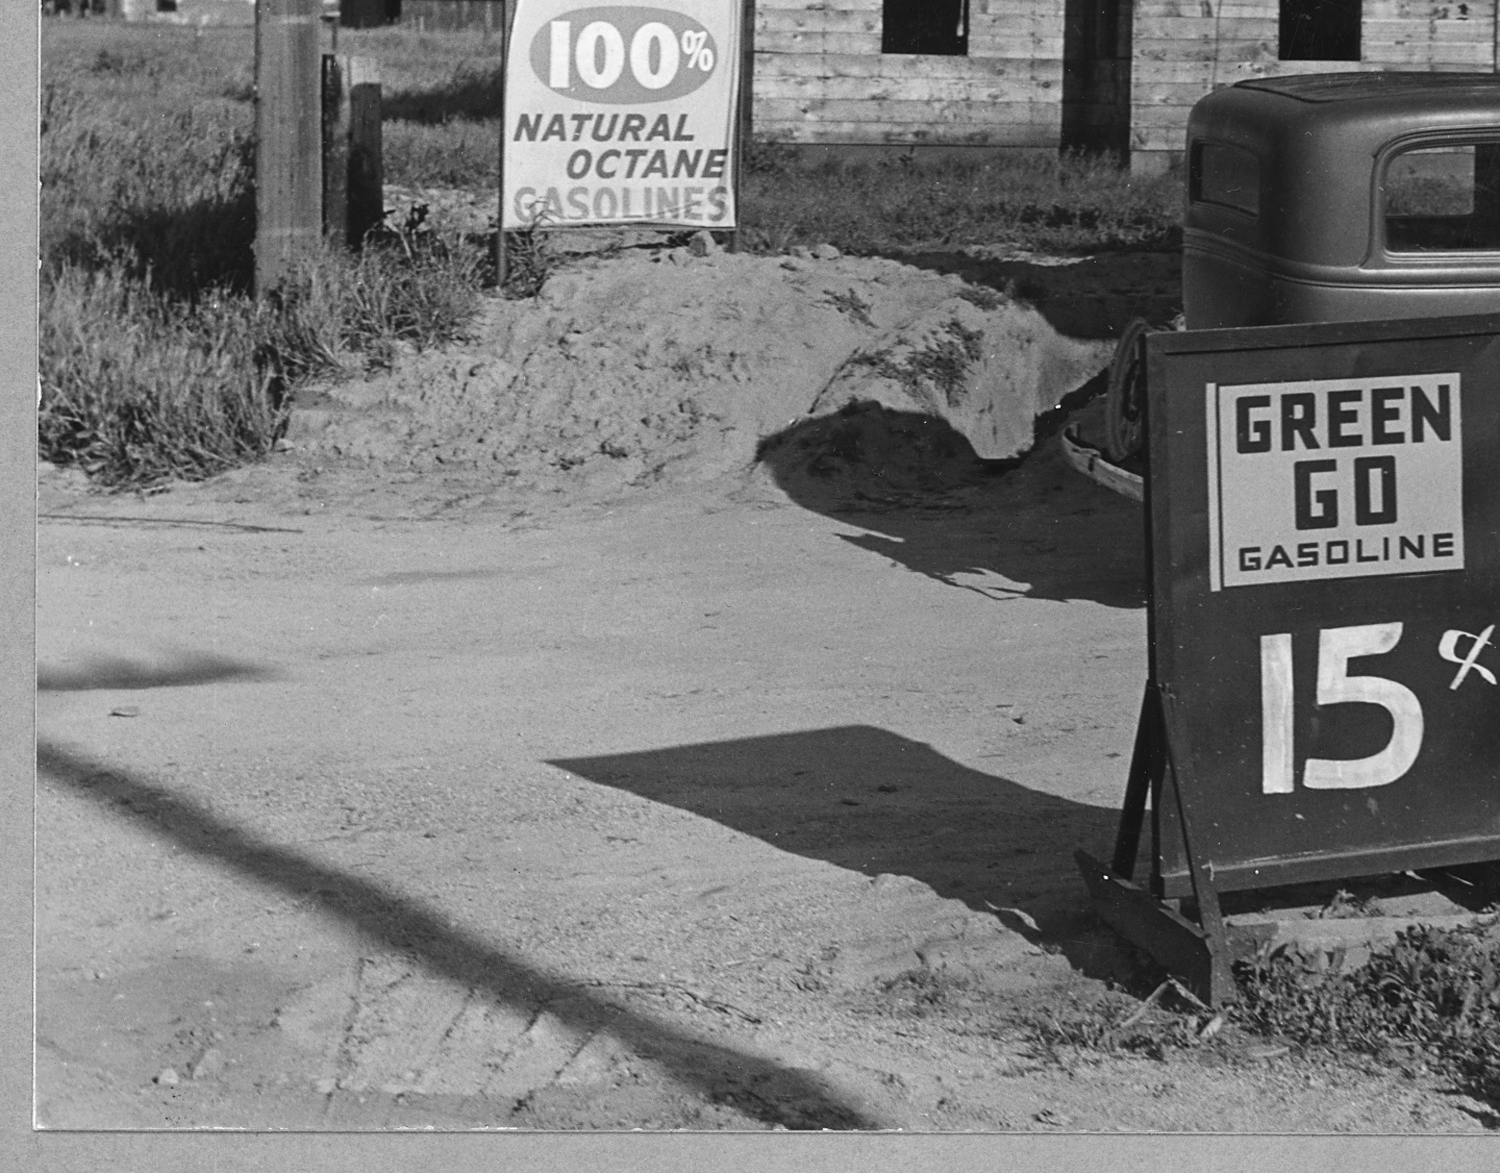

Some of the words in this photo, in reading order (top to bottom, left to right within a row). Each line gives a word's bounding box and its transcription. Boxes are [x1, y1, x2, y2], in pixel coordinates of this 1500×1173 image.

[550, 20, 714, 89] 100%
[513, 113, 695, 142] NATURAL
[566, 148, 729, 179] OCTANE
[513, 186, 729, 223] GASOLINES
[1235, 384, 1452, 454] GREEN
[1294, 455, 1398, 531] GO
[1239, 532, 1454, 572] GASOLINE
